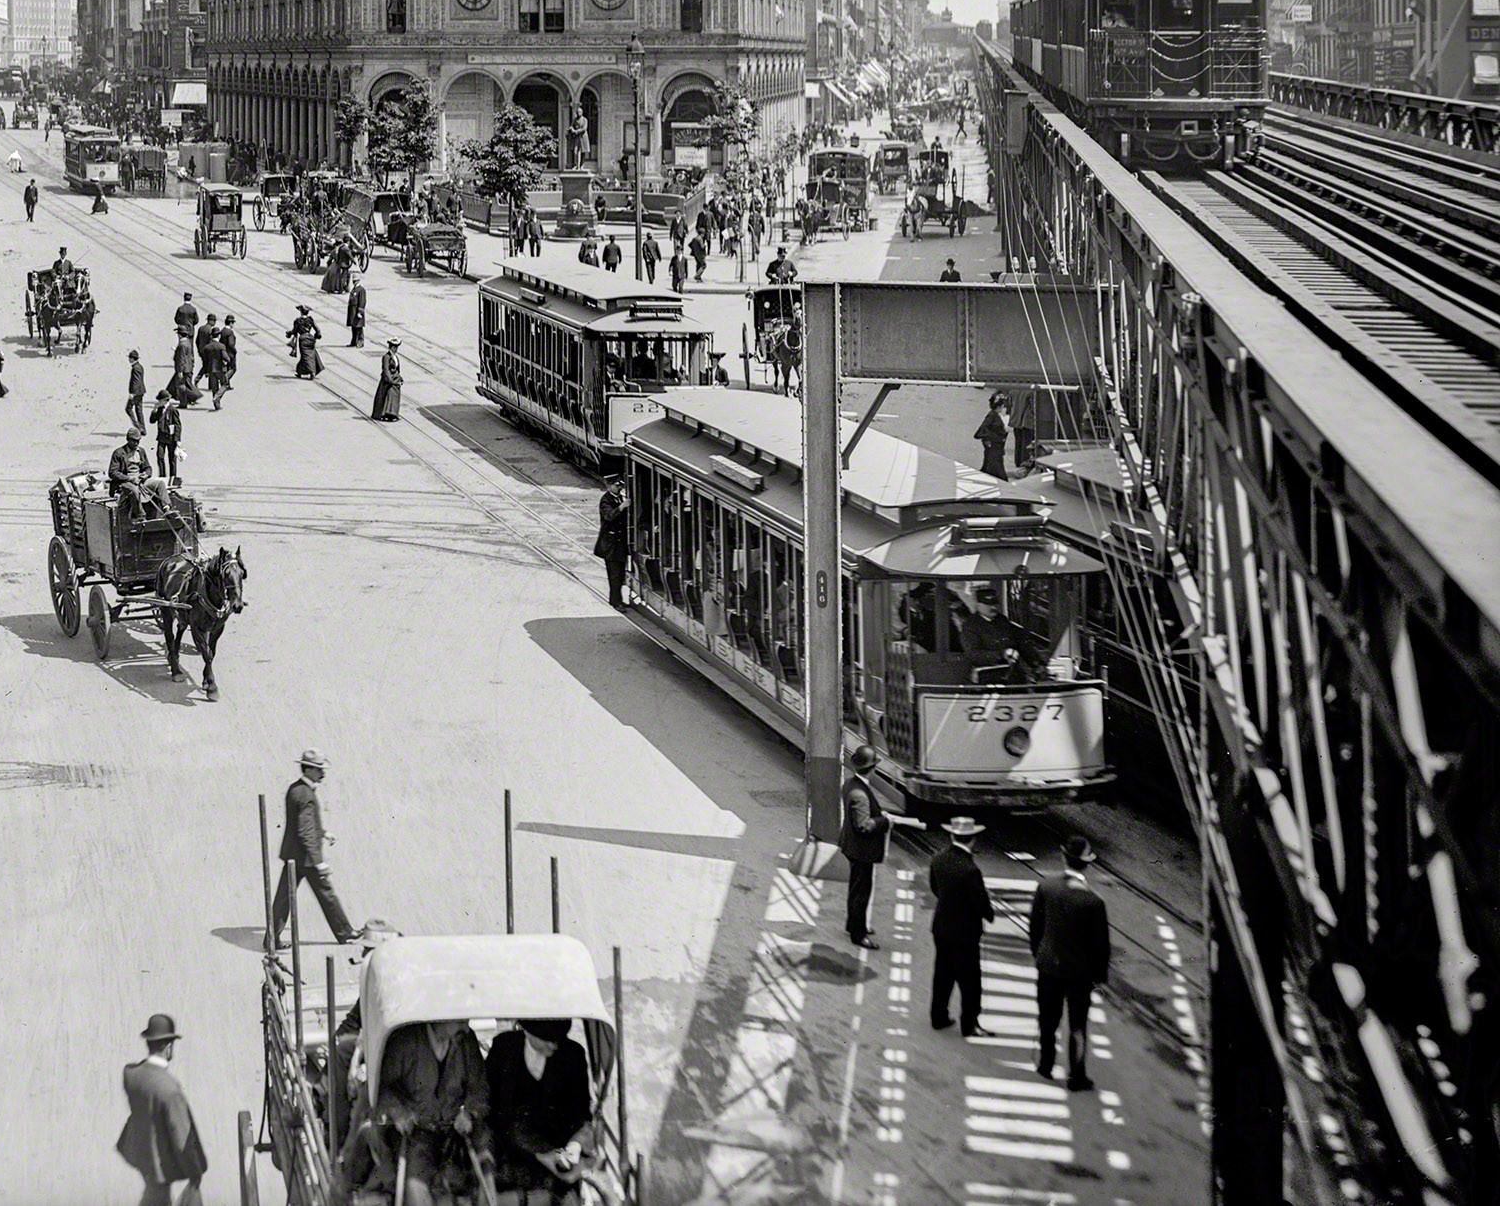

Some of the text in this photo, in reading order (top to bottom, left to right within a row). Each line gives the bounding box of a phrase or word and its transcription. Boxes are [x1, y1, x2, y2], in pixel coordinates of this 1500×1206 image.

[503, 54, 523, 62] NEW
[532, 54, 558, 62] YORK
[966, 704, 1065, 722] 2327
